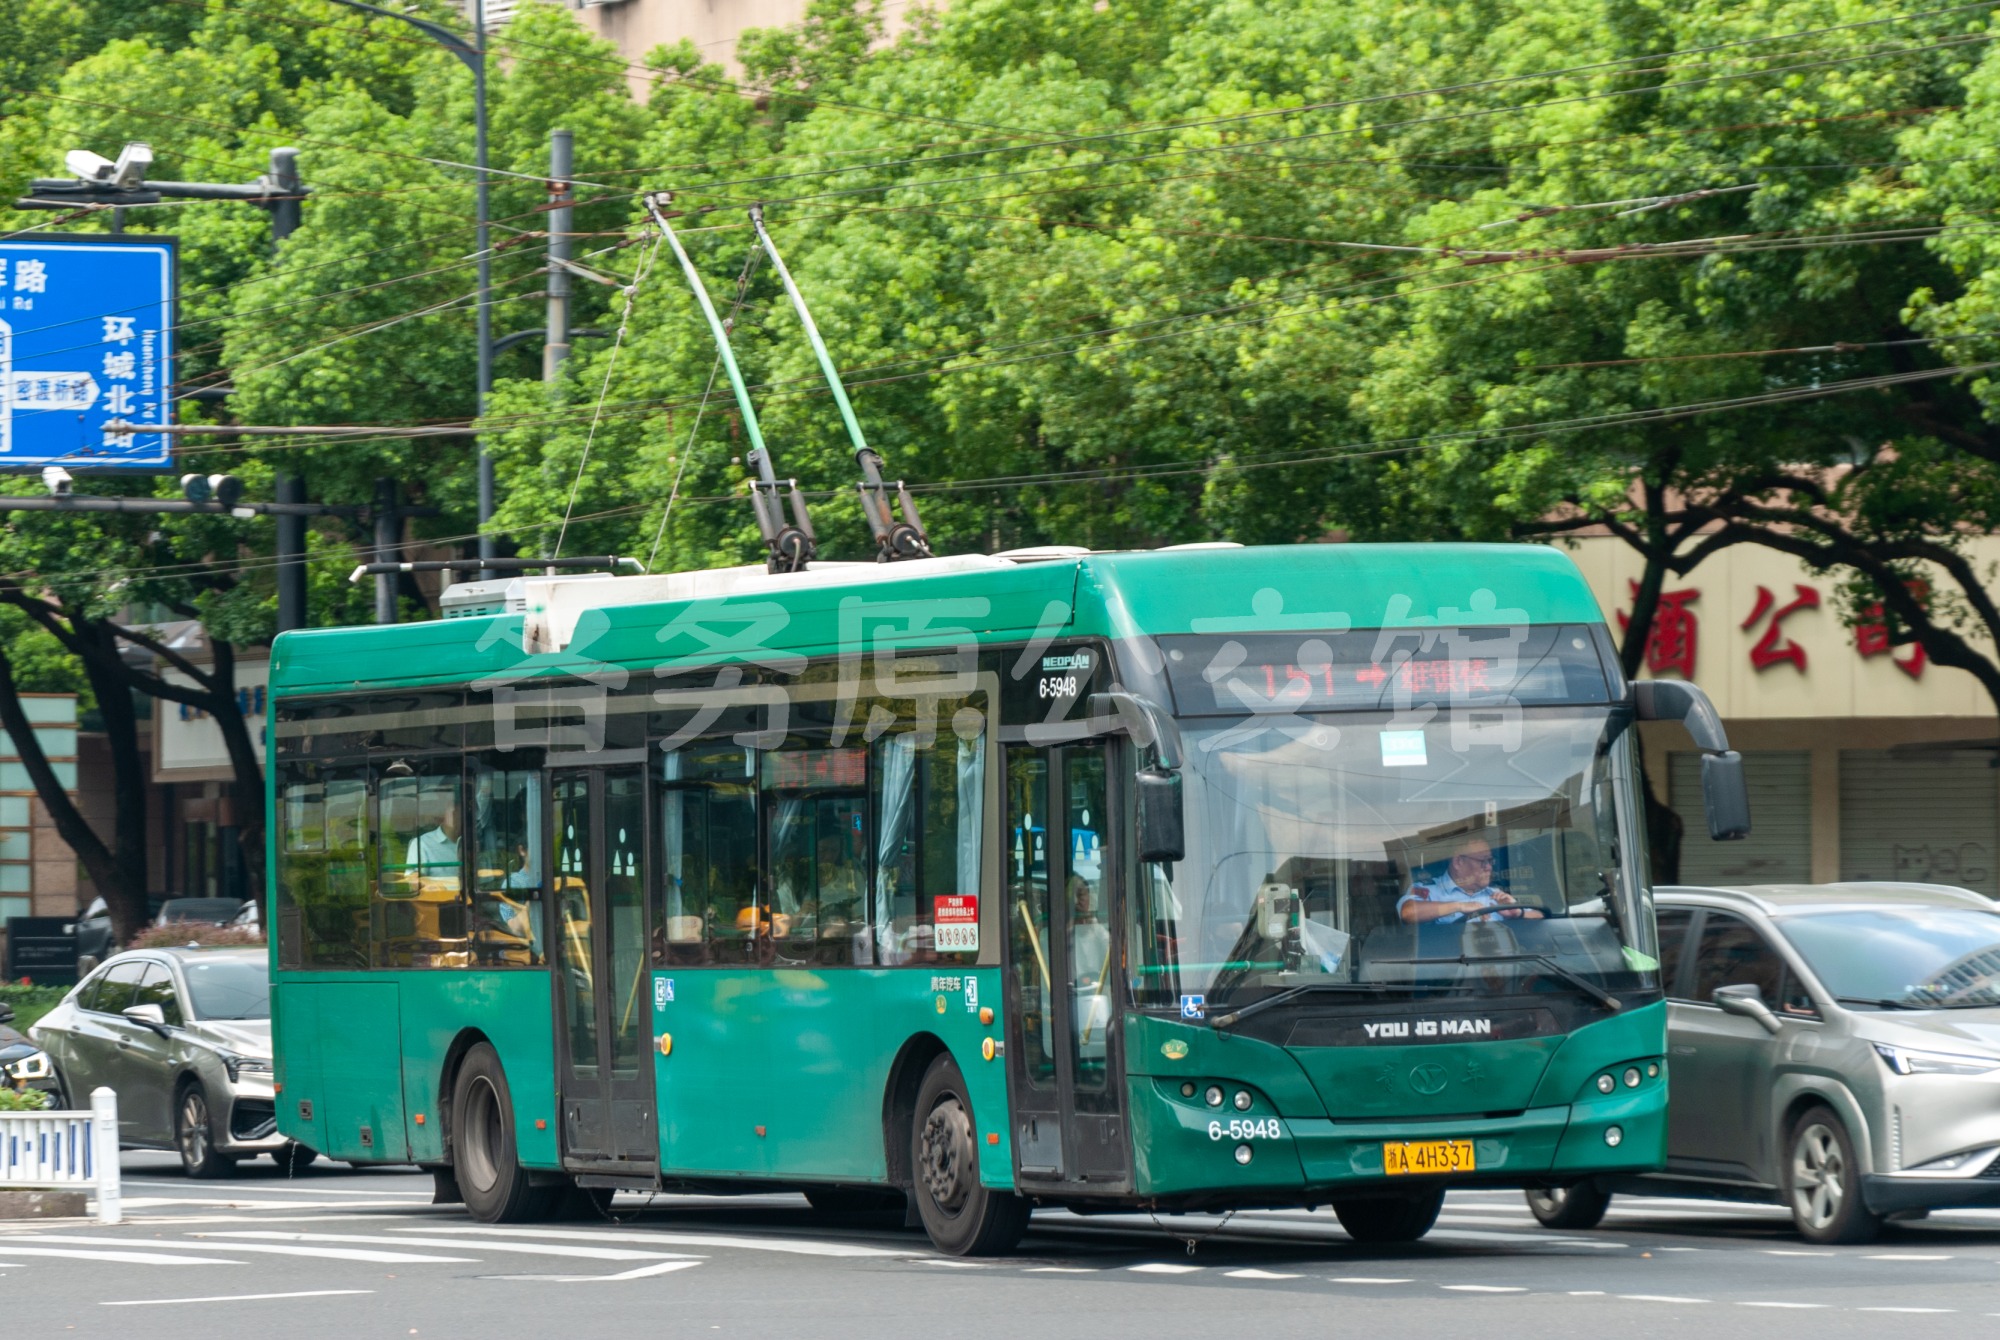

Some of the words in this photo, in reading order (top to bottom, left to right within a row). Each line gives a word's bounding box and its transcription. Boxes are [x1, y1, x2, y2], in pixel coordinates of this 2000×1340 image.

[0, 258, 48, 293] 路
[13, 297, 33, 310] Rd
[102, 316, 136, 447] 环城北路
[1043, 654, 1089, 670] NEOPLAN
[1040, 676, 1077, 698] 6-5948
[1260, 663, 1335, 698] 151
[931, 976, 961, 992] 青年汽车
[1208, 1119, 1281, 1141] 6-5948
